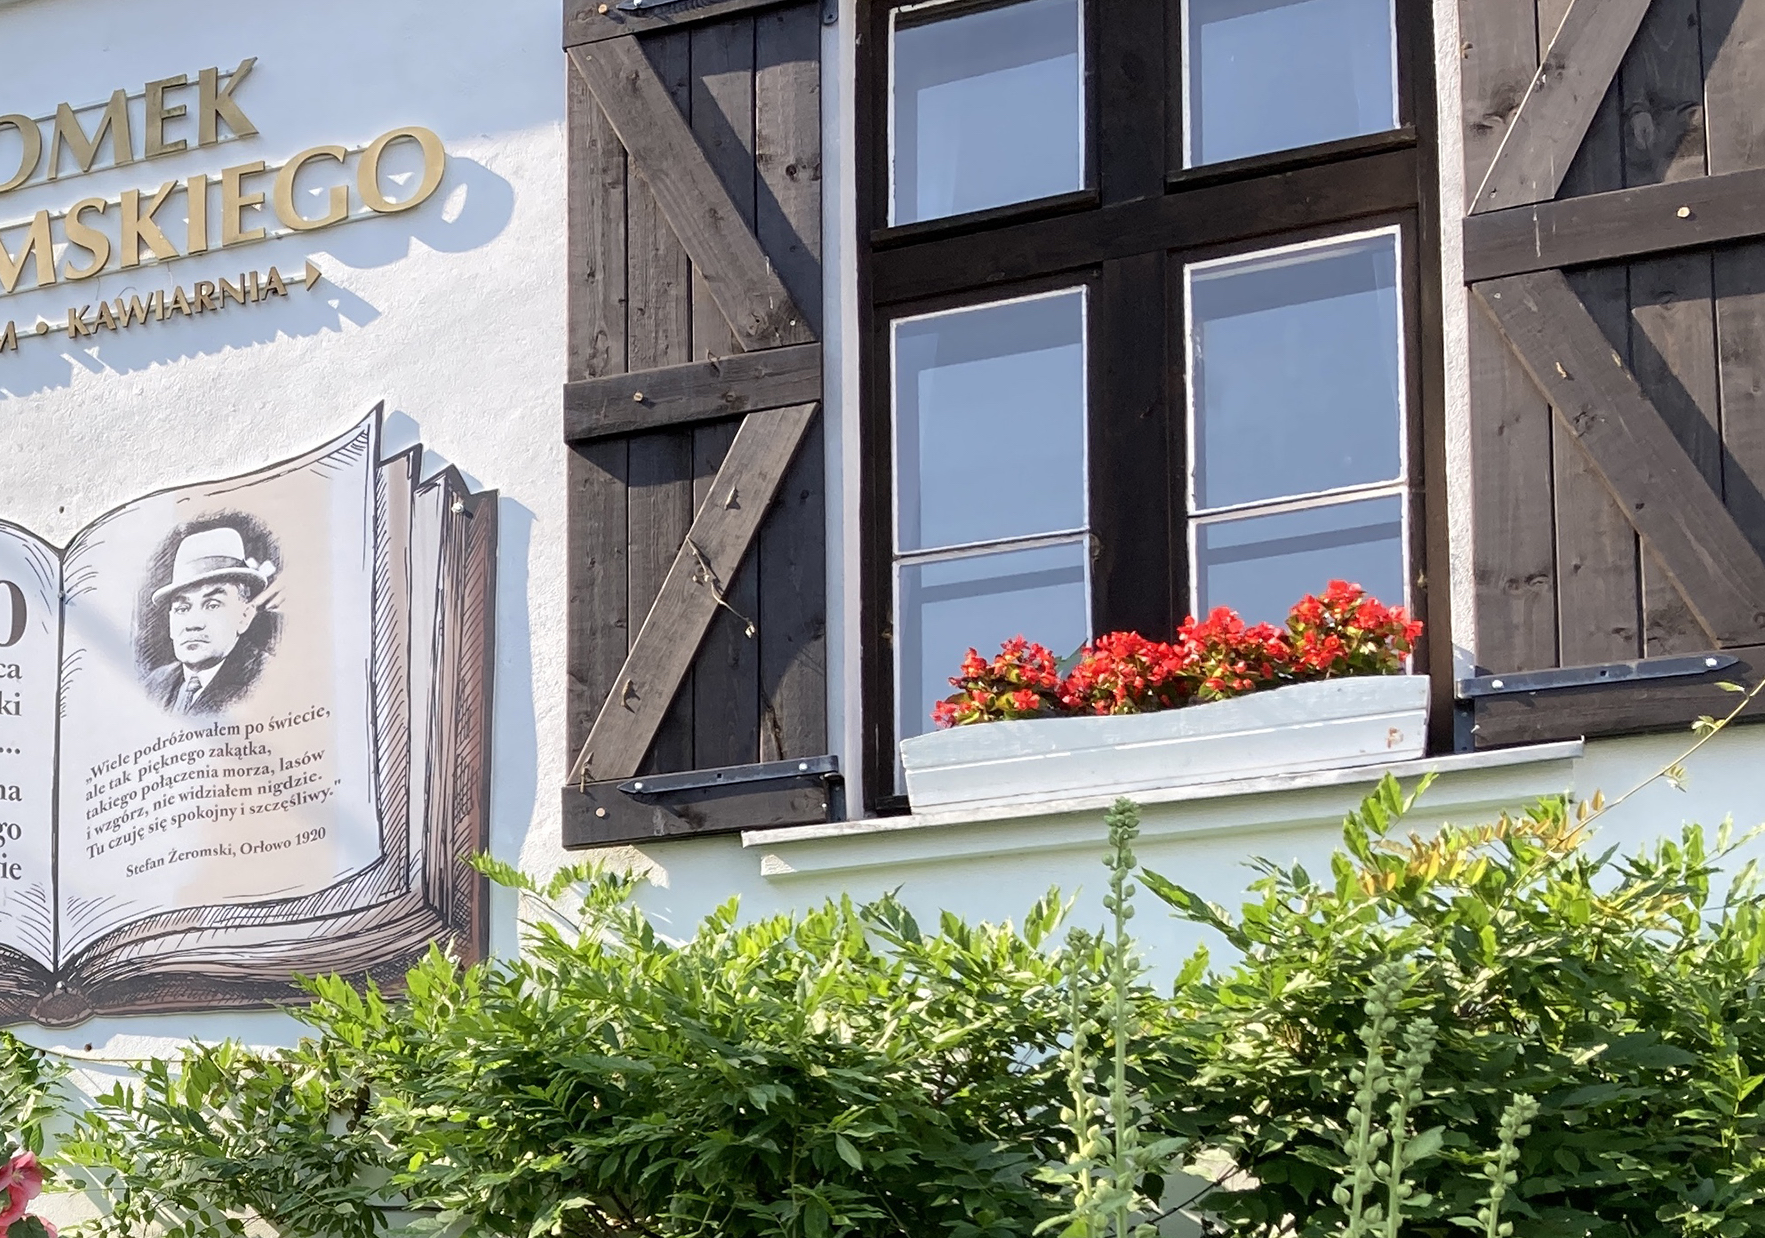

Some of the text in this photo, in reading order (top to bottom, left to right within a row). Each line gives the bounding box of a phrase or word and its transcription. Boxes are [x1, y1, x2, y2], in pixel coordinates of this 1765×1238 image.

[68, 265, 287, 338] KAWIARNIA
[134, 722, 240, 766] podróżowałem
[245, 722, 264, 739] po
[268, 705, 331, 732] świecie,
[86, 741, 272, 801] ale tak pięknego zakątka,
[86, 749, 325, 821] takiego połączenia morza, lasów
[86, 771, 322, 839] i wzgórz, nie widziałem nigdzie.
[86, 843, 104, 860] Tu
[109, 823, 144, 850] czuję
[148, 817, 167, 834] się
[171, 804, 237, 826] spokojny
[240, 804, 245, 816] i
[126, 826, 326, 877] Stefan Żeromski, Orłowo 1920
